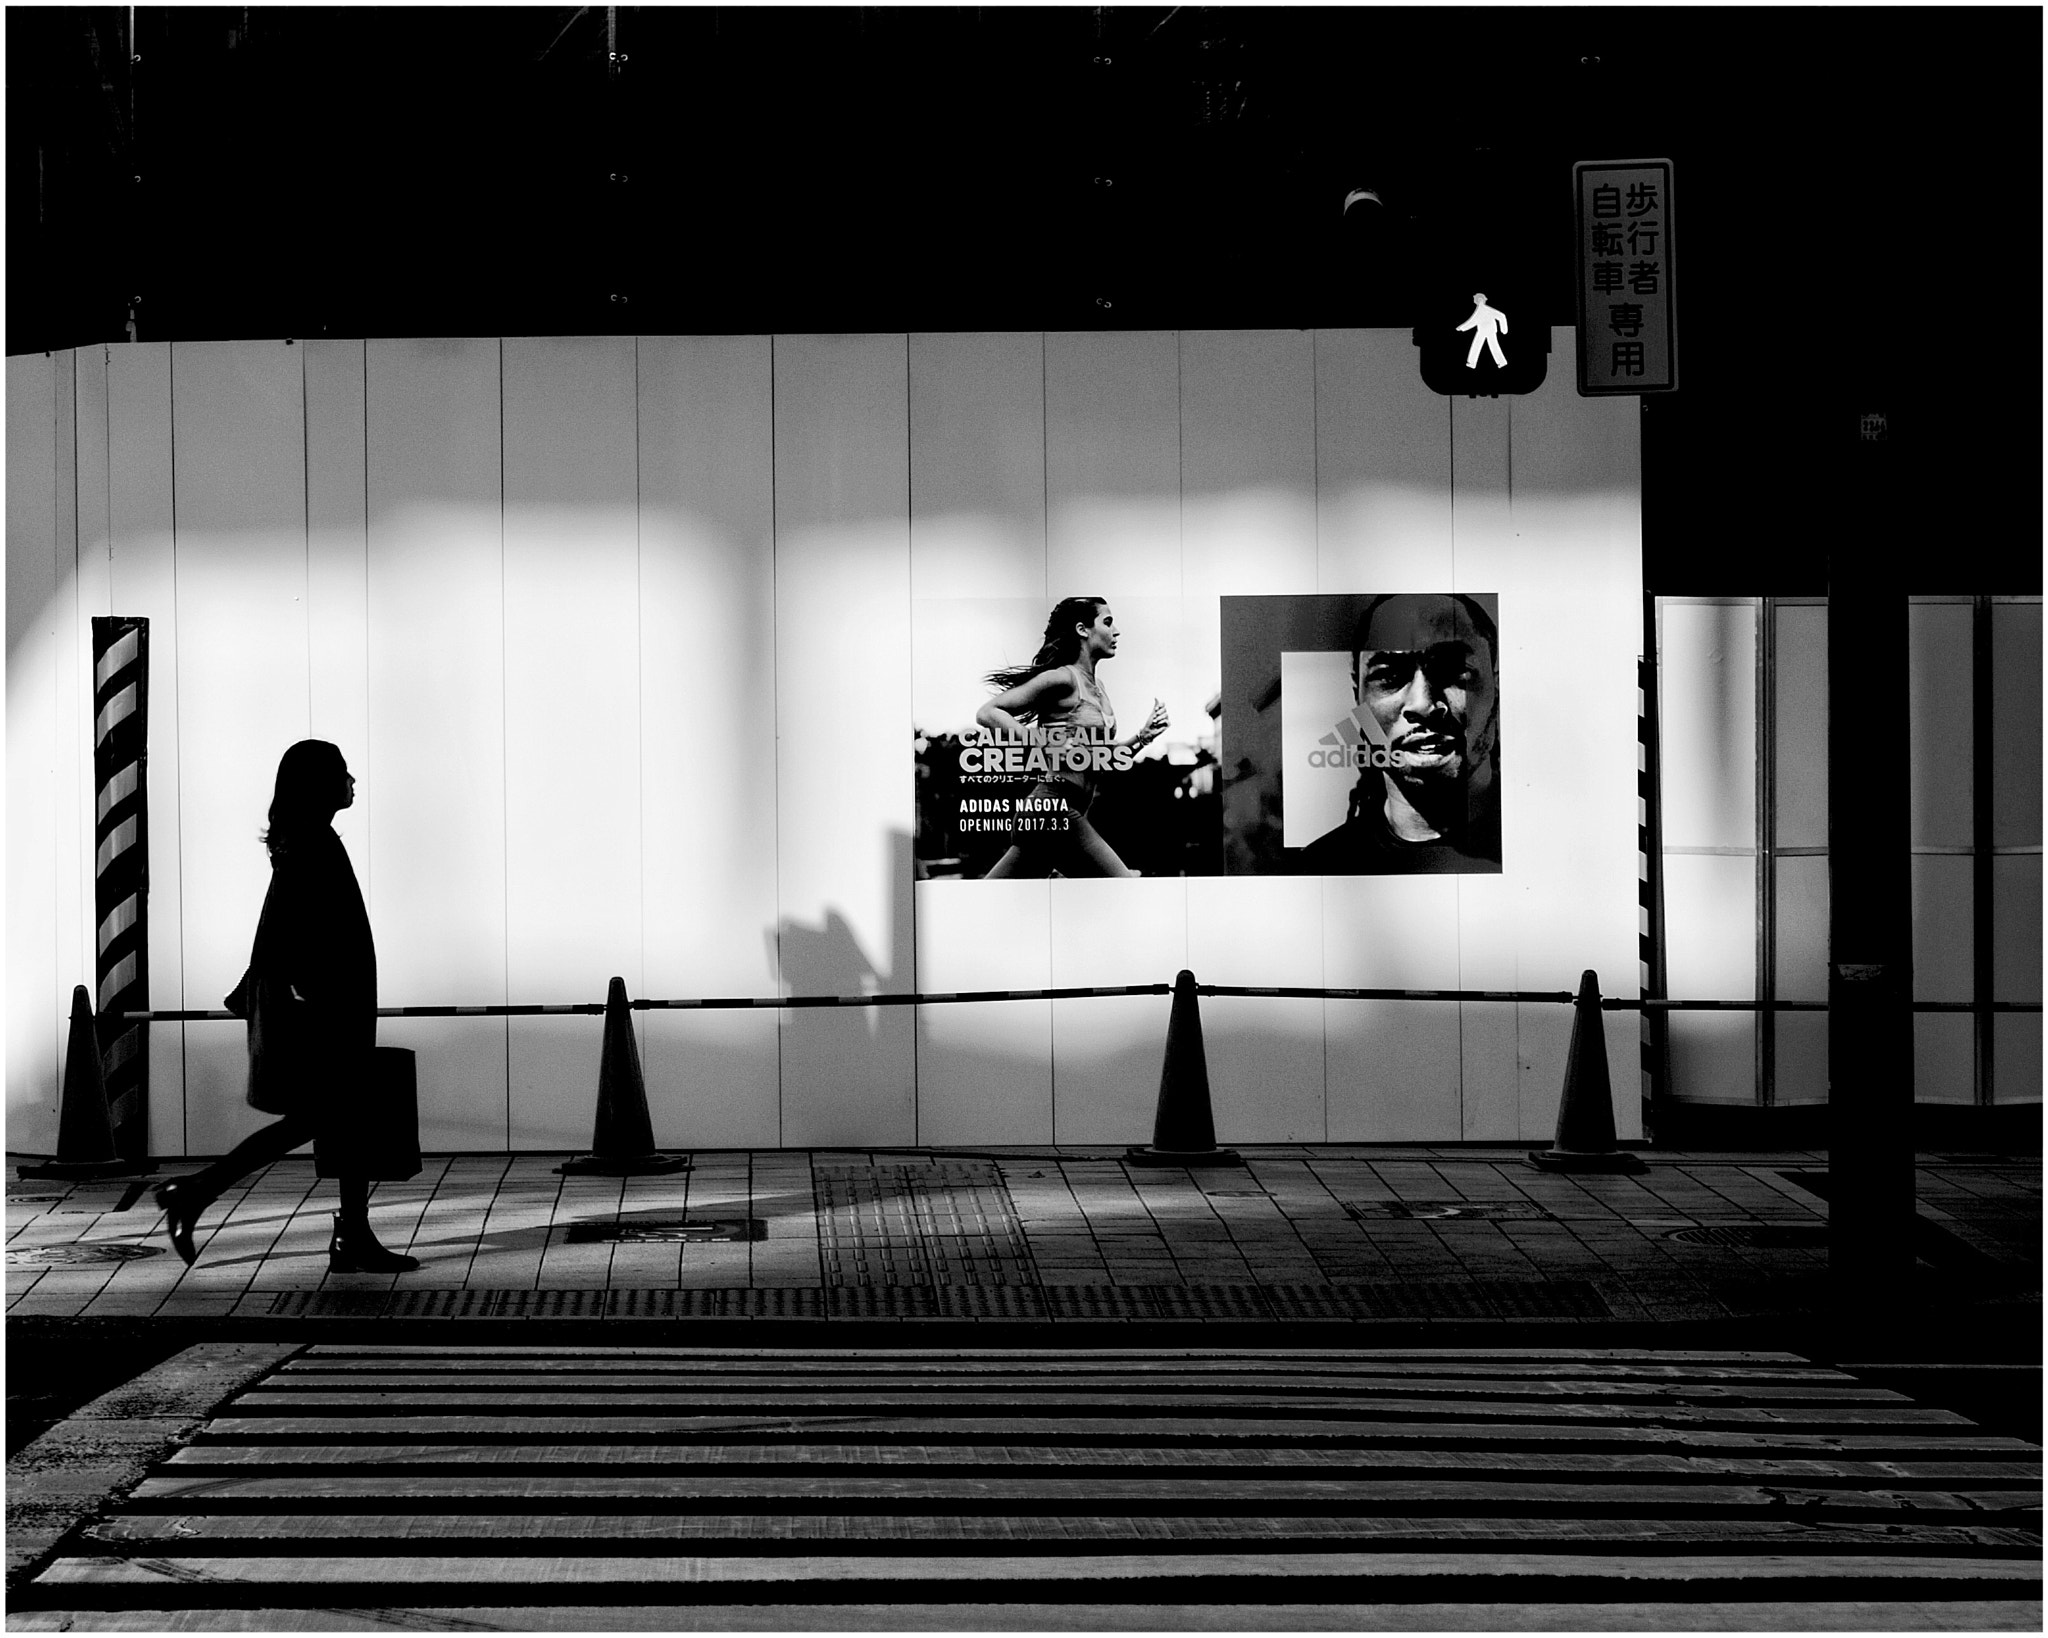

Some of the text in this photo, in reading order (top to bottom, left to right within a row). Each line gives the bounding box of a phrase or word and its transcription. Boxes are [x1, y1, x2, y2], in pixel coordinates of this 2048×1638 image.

[1591, 183, 1625, 296] 自転車
[1626, 182, 1659, 295] 歩行者
[1608, 302, 1645, 377] 専用
[958, 726, 1118, 747] CALLING ALL
[958, 745, 1134, 773] CREATORS
[1307, 744, 1407, 768] adidas
[959, 797, 1069, 813] ADIDAS NAGOYA
[959, 817, 1070, 832] OPENING 2017.3.3
